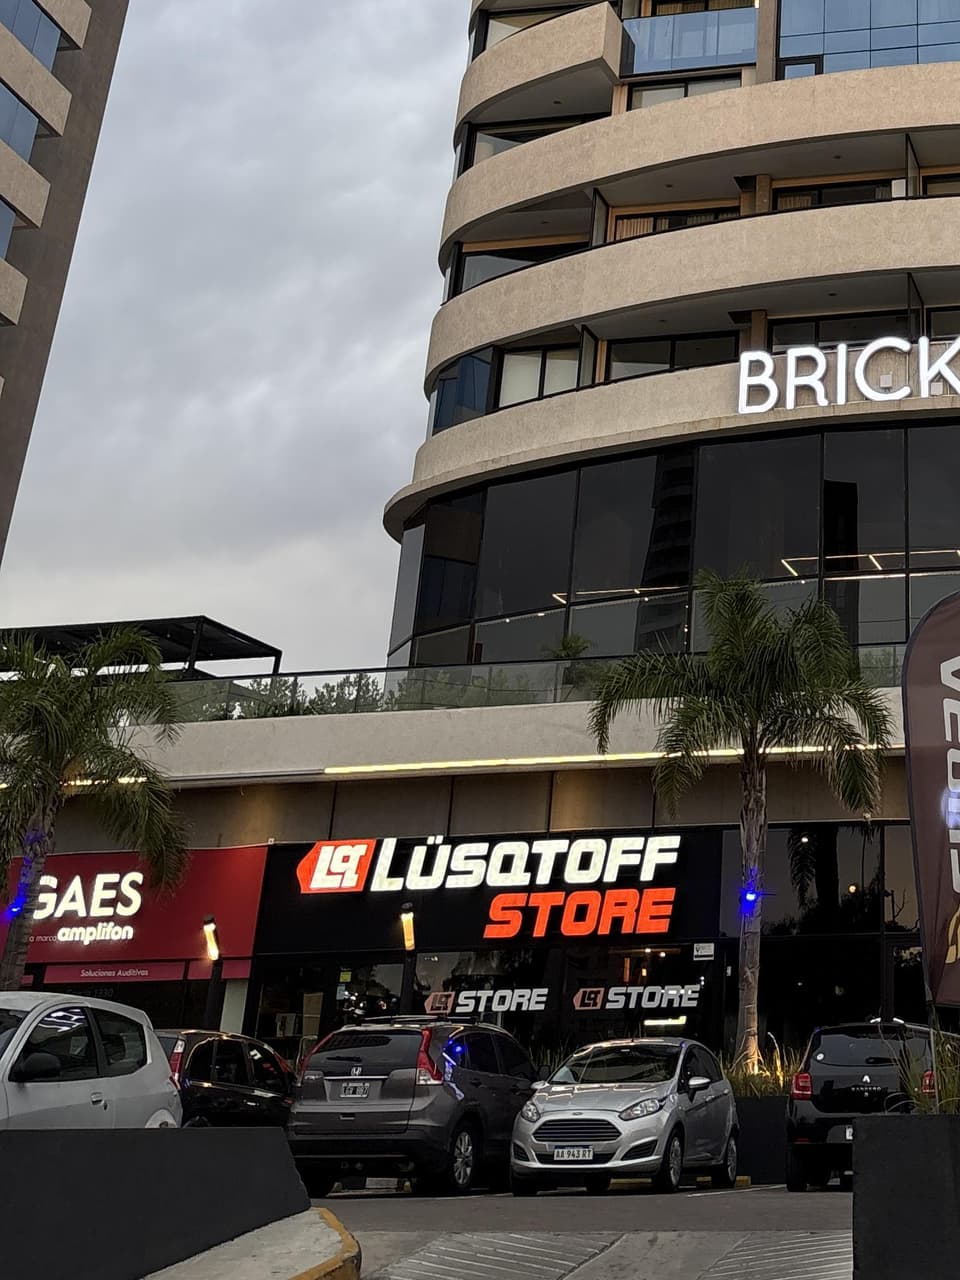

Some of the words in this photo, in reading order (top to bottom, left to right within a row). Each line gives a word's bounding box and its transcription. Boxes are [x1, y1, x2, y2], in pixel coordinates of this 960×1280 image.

[370, 835, 681, 892] LÜSQTOFF
[33, 871, 144, 920] GAES
[483, 888, 676, 939] STORE
[57, 921, 134, 946] amplifon
[80, 969, 115, 977] Soluciones
[117, 968, 149, 977] Auditivas
[455, 988, 549, 1013] STORE
[605, 984, 700, 1009] STORE
